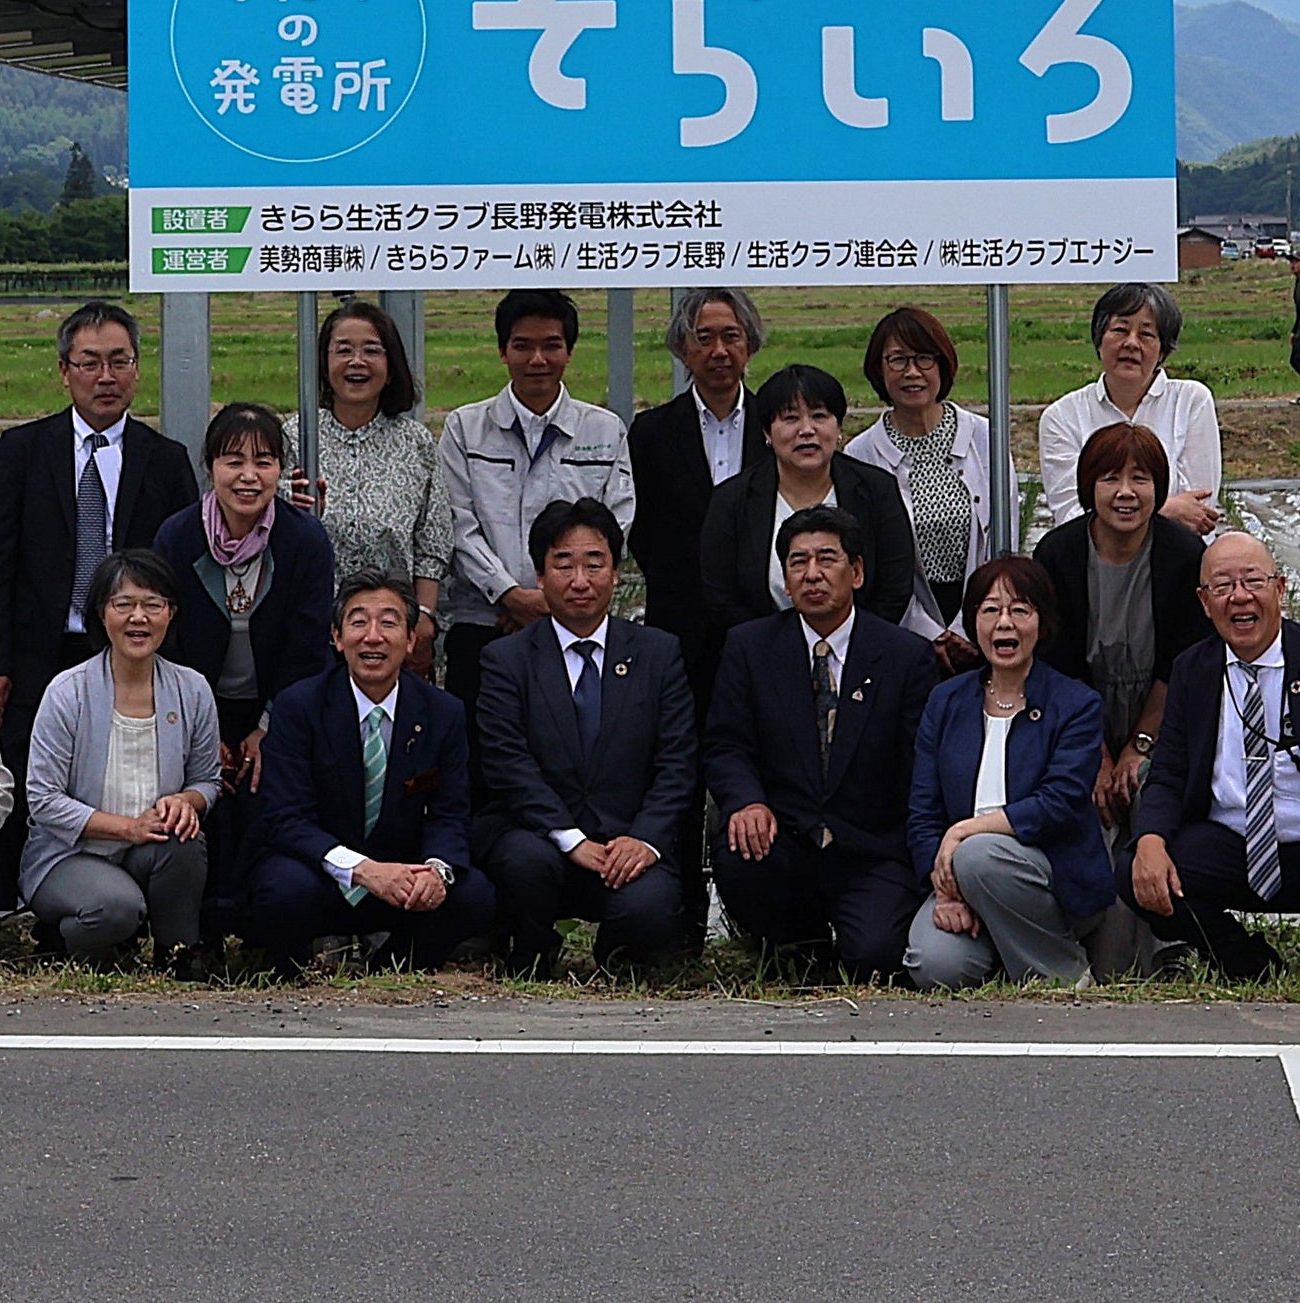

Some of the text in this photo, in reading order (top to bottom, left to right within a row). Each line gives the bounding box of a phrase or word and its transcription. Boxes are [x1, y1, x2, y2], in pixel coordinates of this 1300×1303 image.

[277, 14, 319, 47] の
[209, 56, 392, 116] 発電所
[163, 208, 229, 231] 設置者
[260, 199, 723, 232] きらら生活クラブ長野発電株式会社
[163, 249, 229, 271] 運営者
